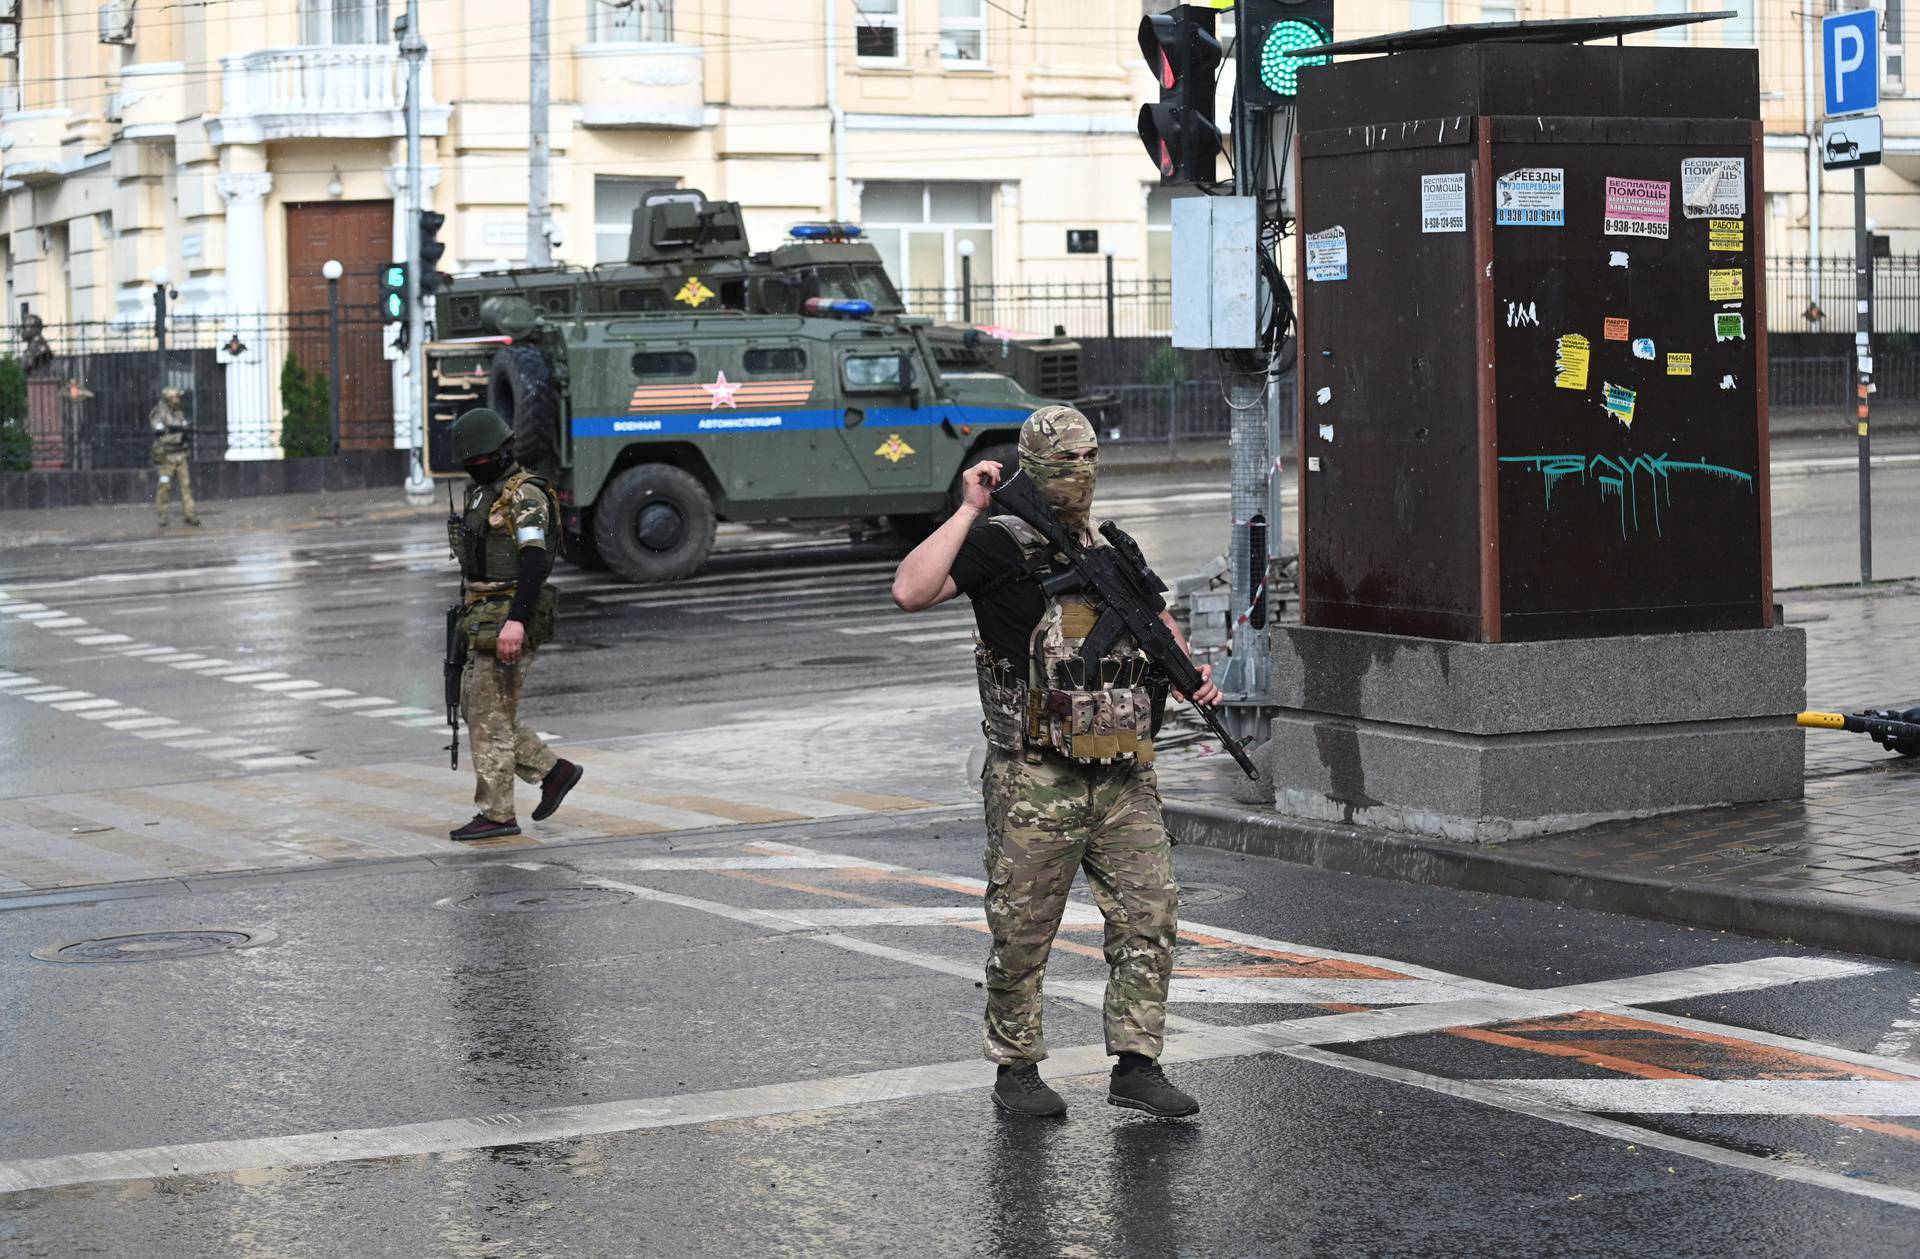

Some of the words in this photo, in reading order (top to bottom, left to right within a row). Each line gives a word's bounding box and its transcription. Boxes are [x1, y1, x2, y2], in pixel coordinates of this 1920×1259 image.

[1834, 25, 1864, 103] P
[1423, 176, 1463, 184] БЕСПЛАТНАЯ
[1609, 180, 1667, 190] БЕСПЛАТНАЯ
[1423, 183, 1463, 193] ПОМОЩЬ
[1608, 186, 1666, 200] ПОМОЩЬ
[1499, 209, 1504, 222] 8
[1605, 219, 1667, 236] 8-938-124-9555
[1712, 221, 1740, 230] РАБОТА
[613, 420, 661, 431] ВОЕННАЯ
[698, 416, 782, 429] АВТОИНСПЕКЦИЯ
